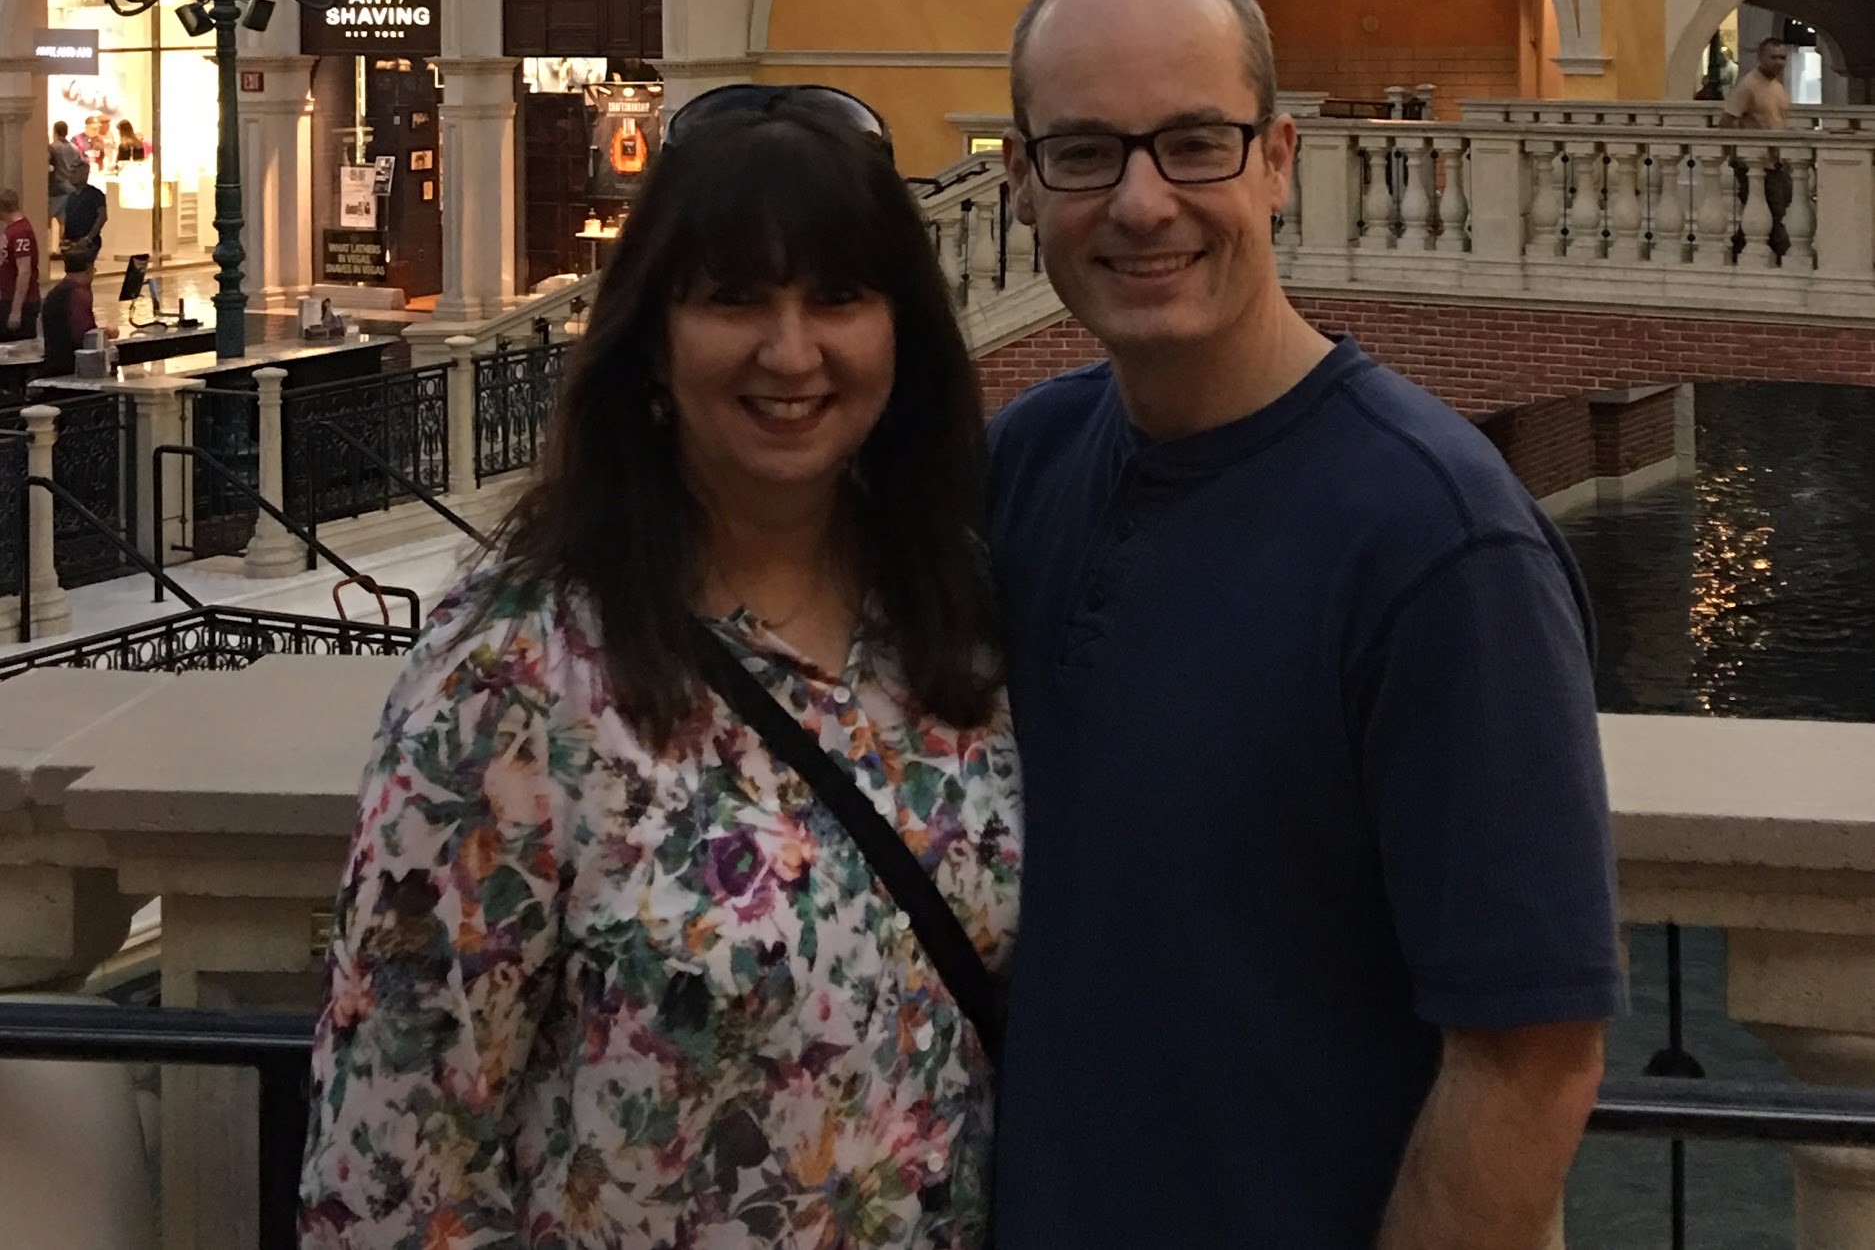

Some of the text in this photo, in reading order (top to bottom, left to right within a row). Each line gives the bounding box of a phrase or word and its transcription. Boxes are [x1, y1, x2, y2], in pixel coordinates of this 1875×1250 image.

[325, 6, 431, 26] SHAVING
[15, 238, 31, 252] 72
[328, 243, 350, 253] WHAT
[338, 254, 346, 263] IN
[325, 263, 352, 274] SHAVES
[353, 265, 361, 274] IN
